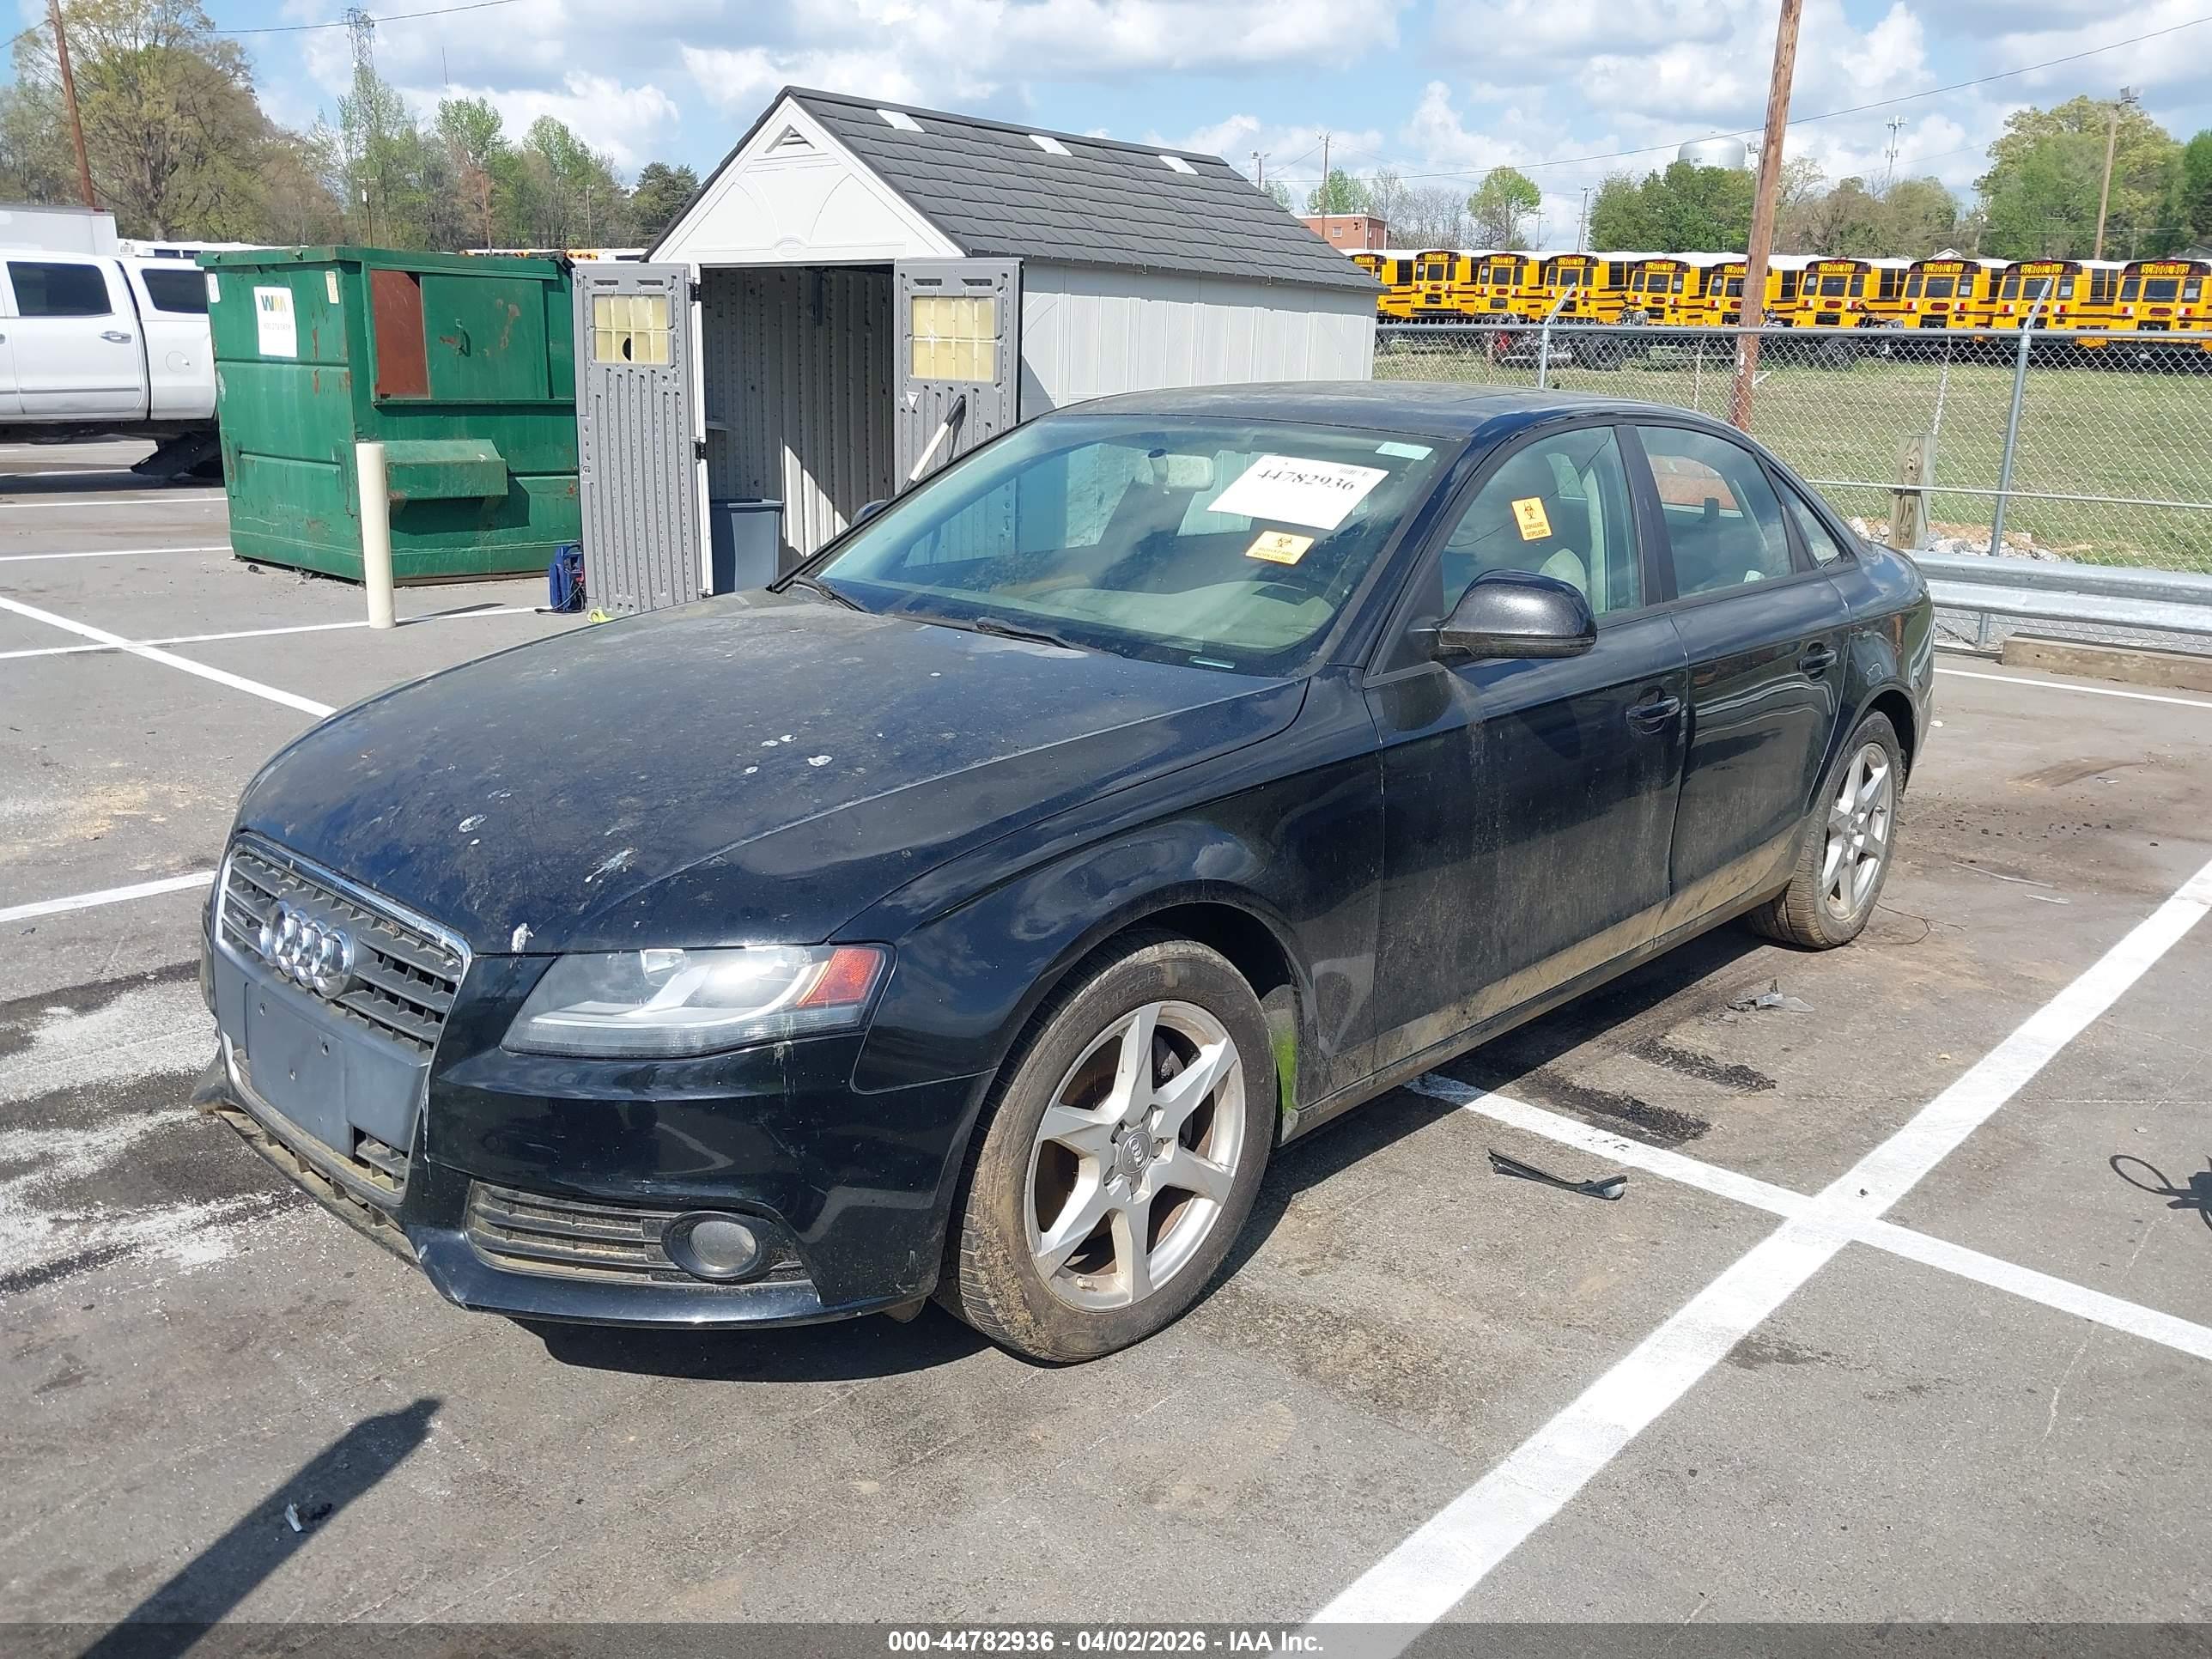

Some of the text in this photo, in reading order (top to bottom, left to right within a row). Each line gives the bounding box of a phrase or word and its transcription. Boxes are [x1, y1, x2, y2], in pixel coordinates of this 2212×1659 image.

[1820, 264, 1854, 273] SCHOOL BUS
[1925, 264, 1962, 273] SCHOOL BUS
[2021, 264, 2063, 275] SCHOOL BUS
[2142, 264, 2190, 276] SCHOOL BUS
[260, 295, 287, 313] WM
[1257, 469, 1354, 490] 44782936
